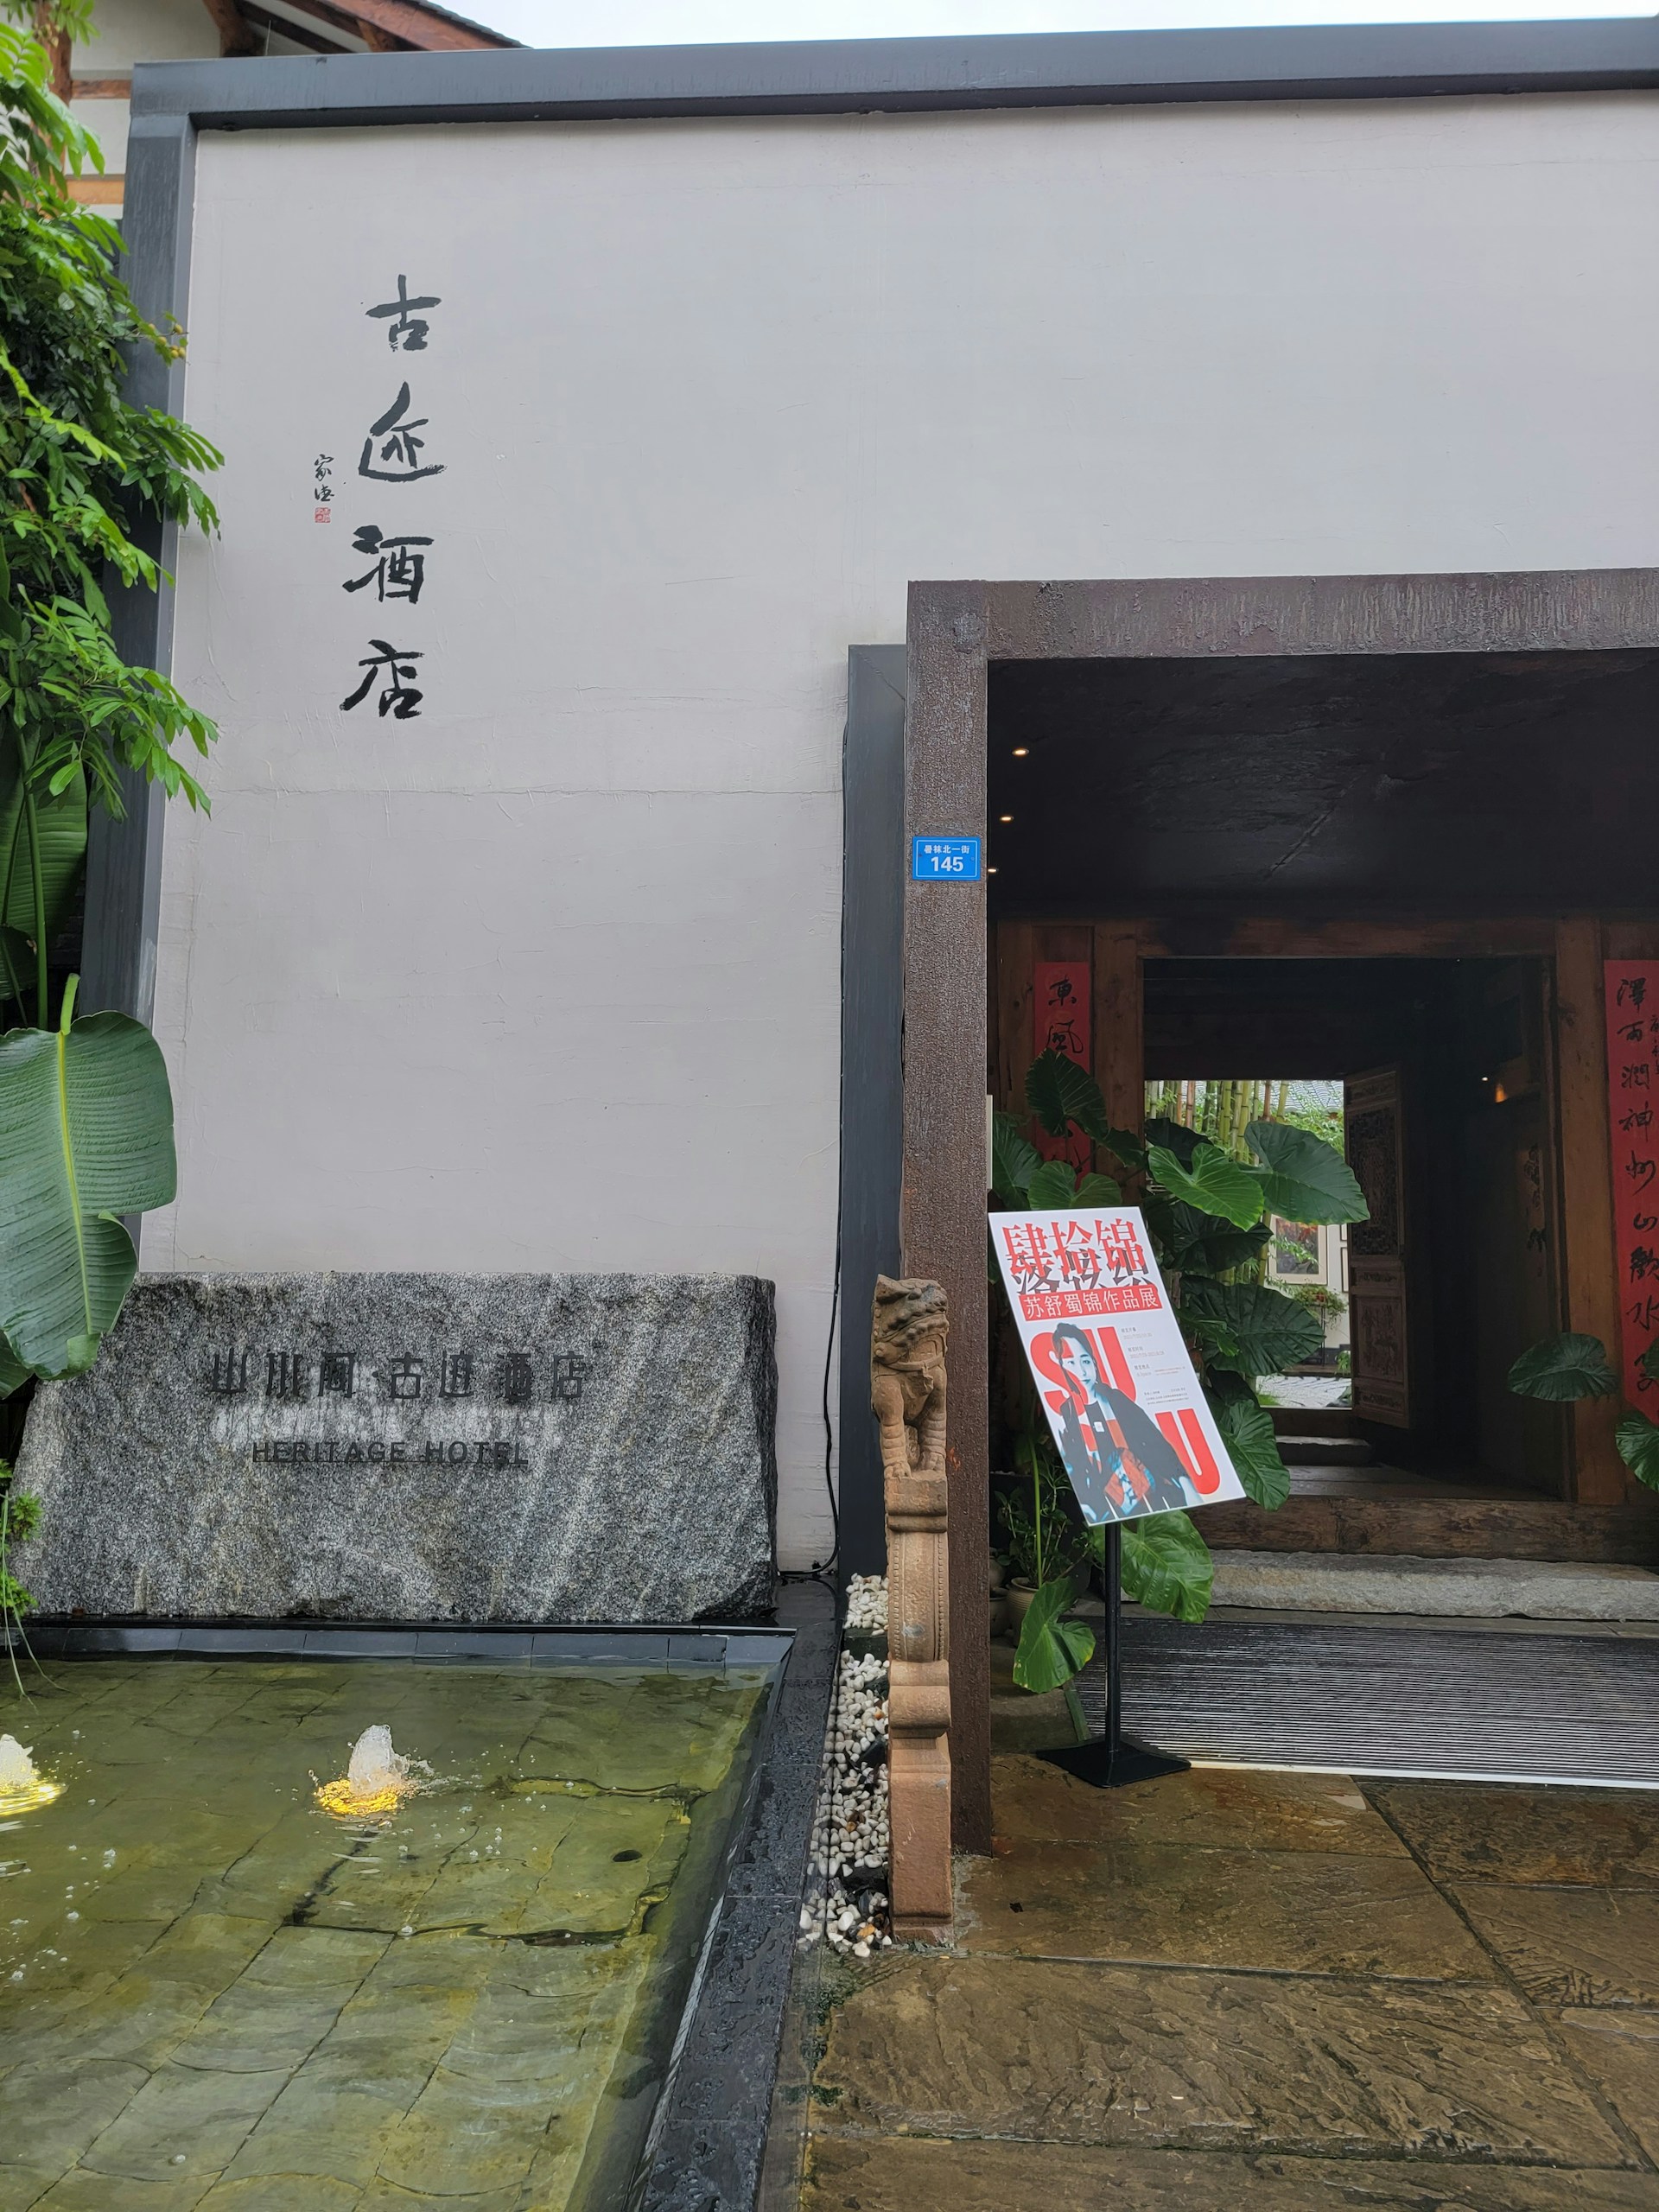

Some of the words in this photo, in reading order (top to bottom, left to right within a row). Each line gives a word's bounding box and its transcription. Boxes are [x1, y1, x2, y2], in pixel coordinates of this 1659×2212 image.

[340, 274, 448, 719] 古迹酒店
[931, 856, 964, 872] 145
[1001, 1217, 1145, 1280] 肆拾锦
[1023, 1287, 1159, 1319] 苏舒蜀锦作品展
[252, 1441, 405, 1463] HERITAGE
[426, 1441, 529, 1465] HOTEL
